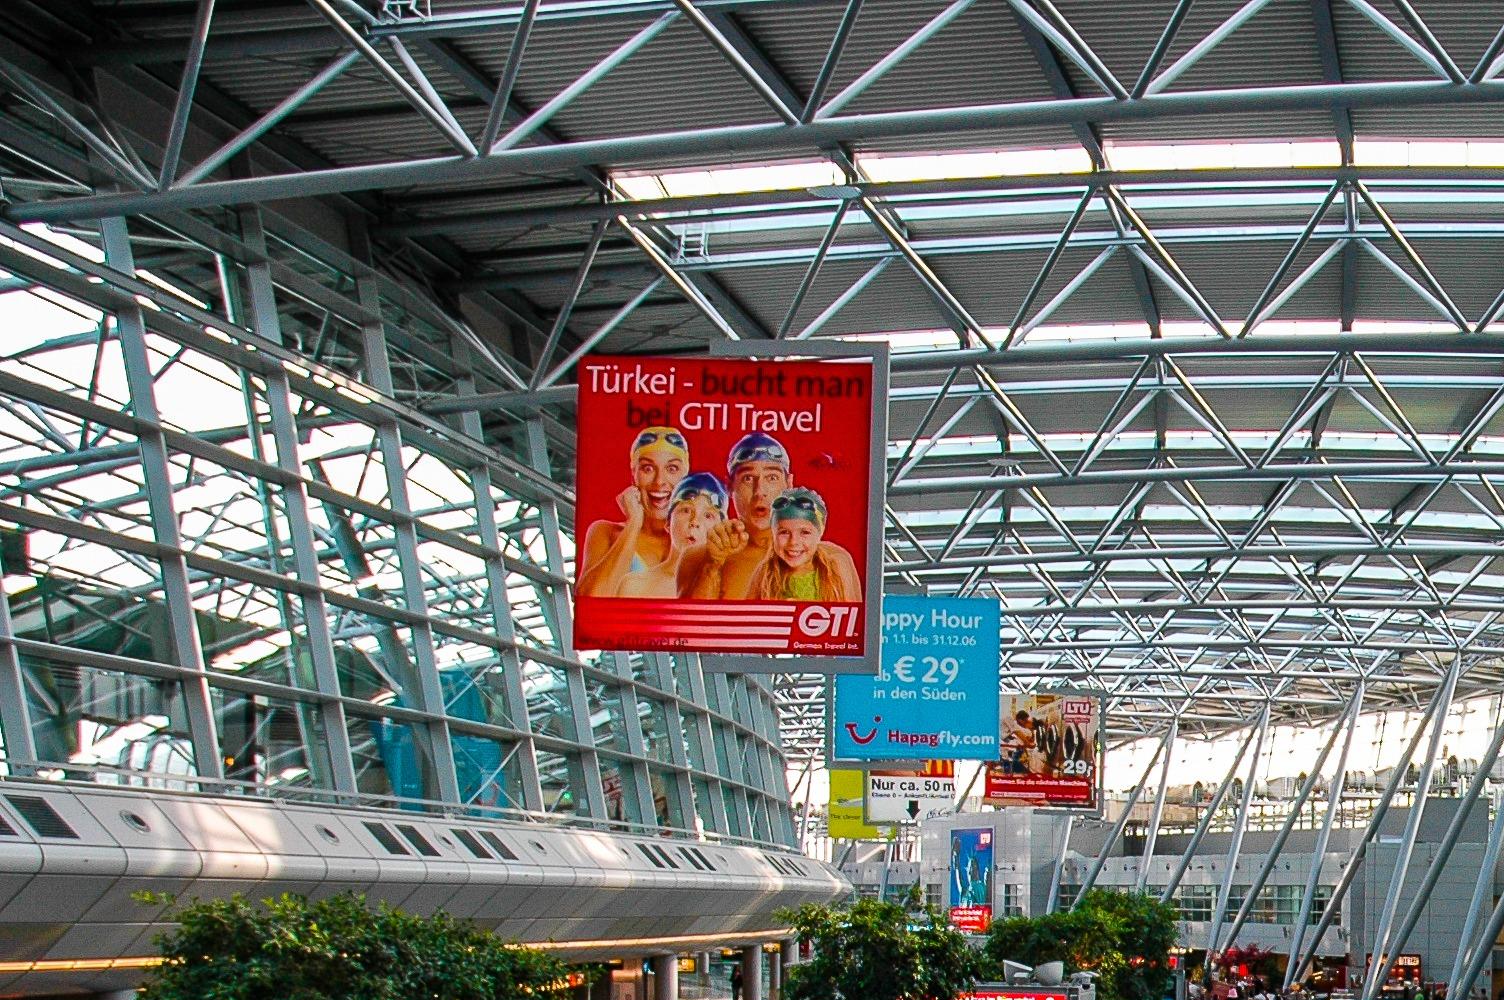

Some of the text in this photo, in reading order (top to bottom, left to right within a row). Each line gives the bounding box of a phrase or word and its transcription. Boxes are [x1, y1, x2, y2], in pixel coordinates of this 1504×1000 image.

[586, 365, 676, 395] Türkei
[702, 367, 787, 397] bucht
[795, 375, 864, 398] man
[627, 401, 822, 432] bei GTI Travel
[798, 605, 859, 638] GTI
[883, 609, 984, 632] ppy Hour
[894, 634, 909, 645] 1.1.
[911, 634, 929, 645] bis
[874, 670, 892, 682] ab
[873, 687, 967, 701] in den Süden
[1067, 702, 1089, 714] LTU
[887, 730, 995, 748] Hapagfly.com
[871, 778, 955, 791] Nur ca. 50 m
